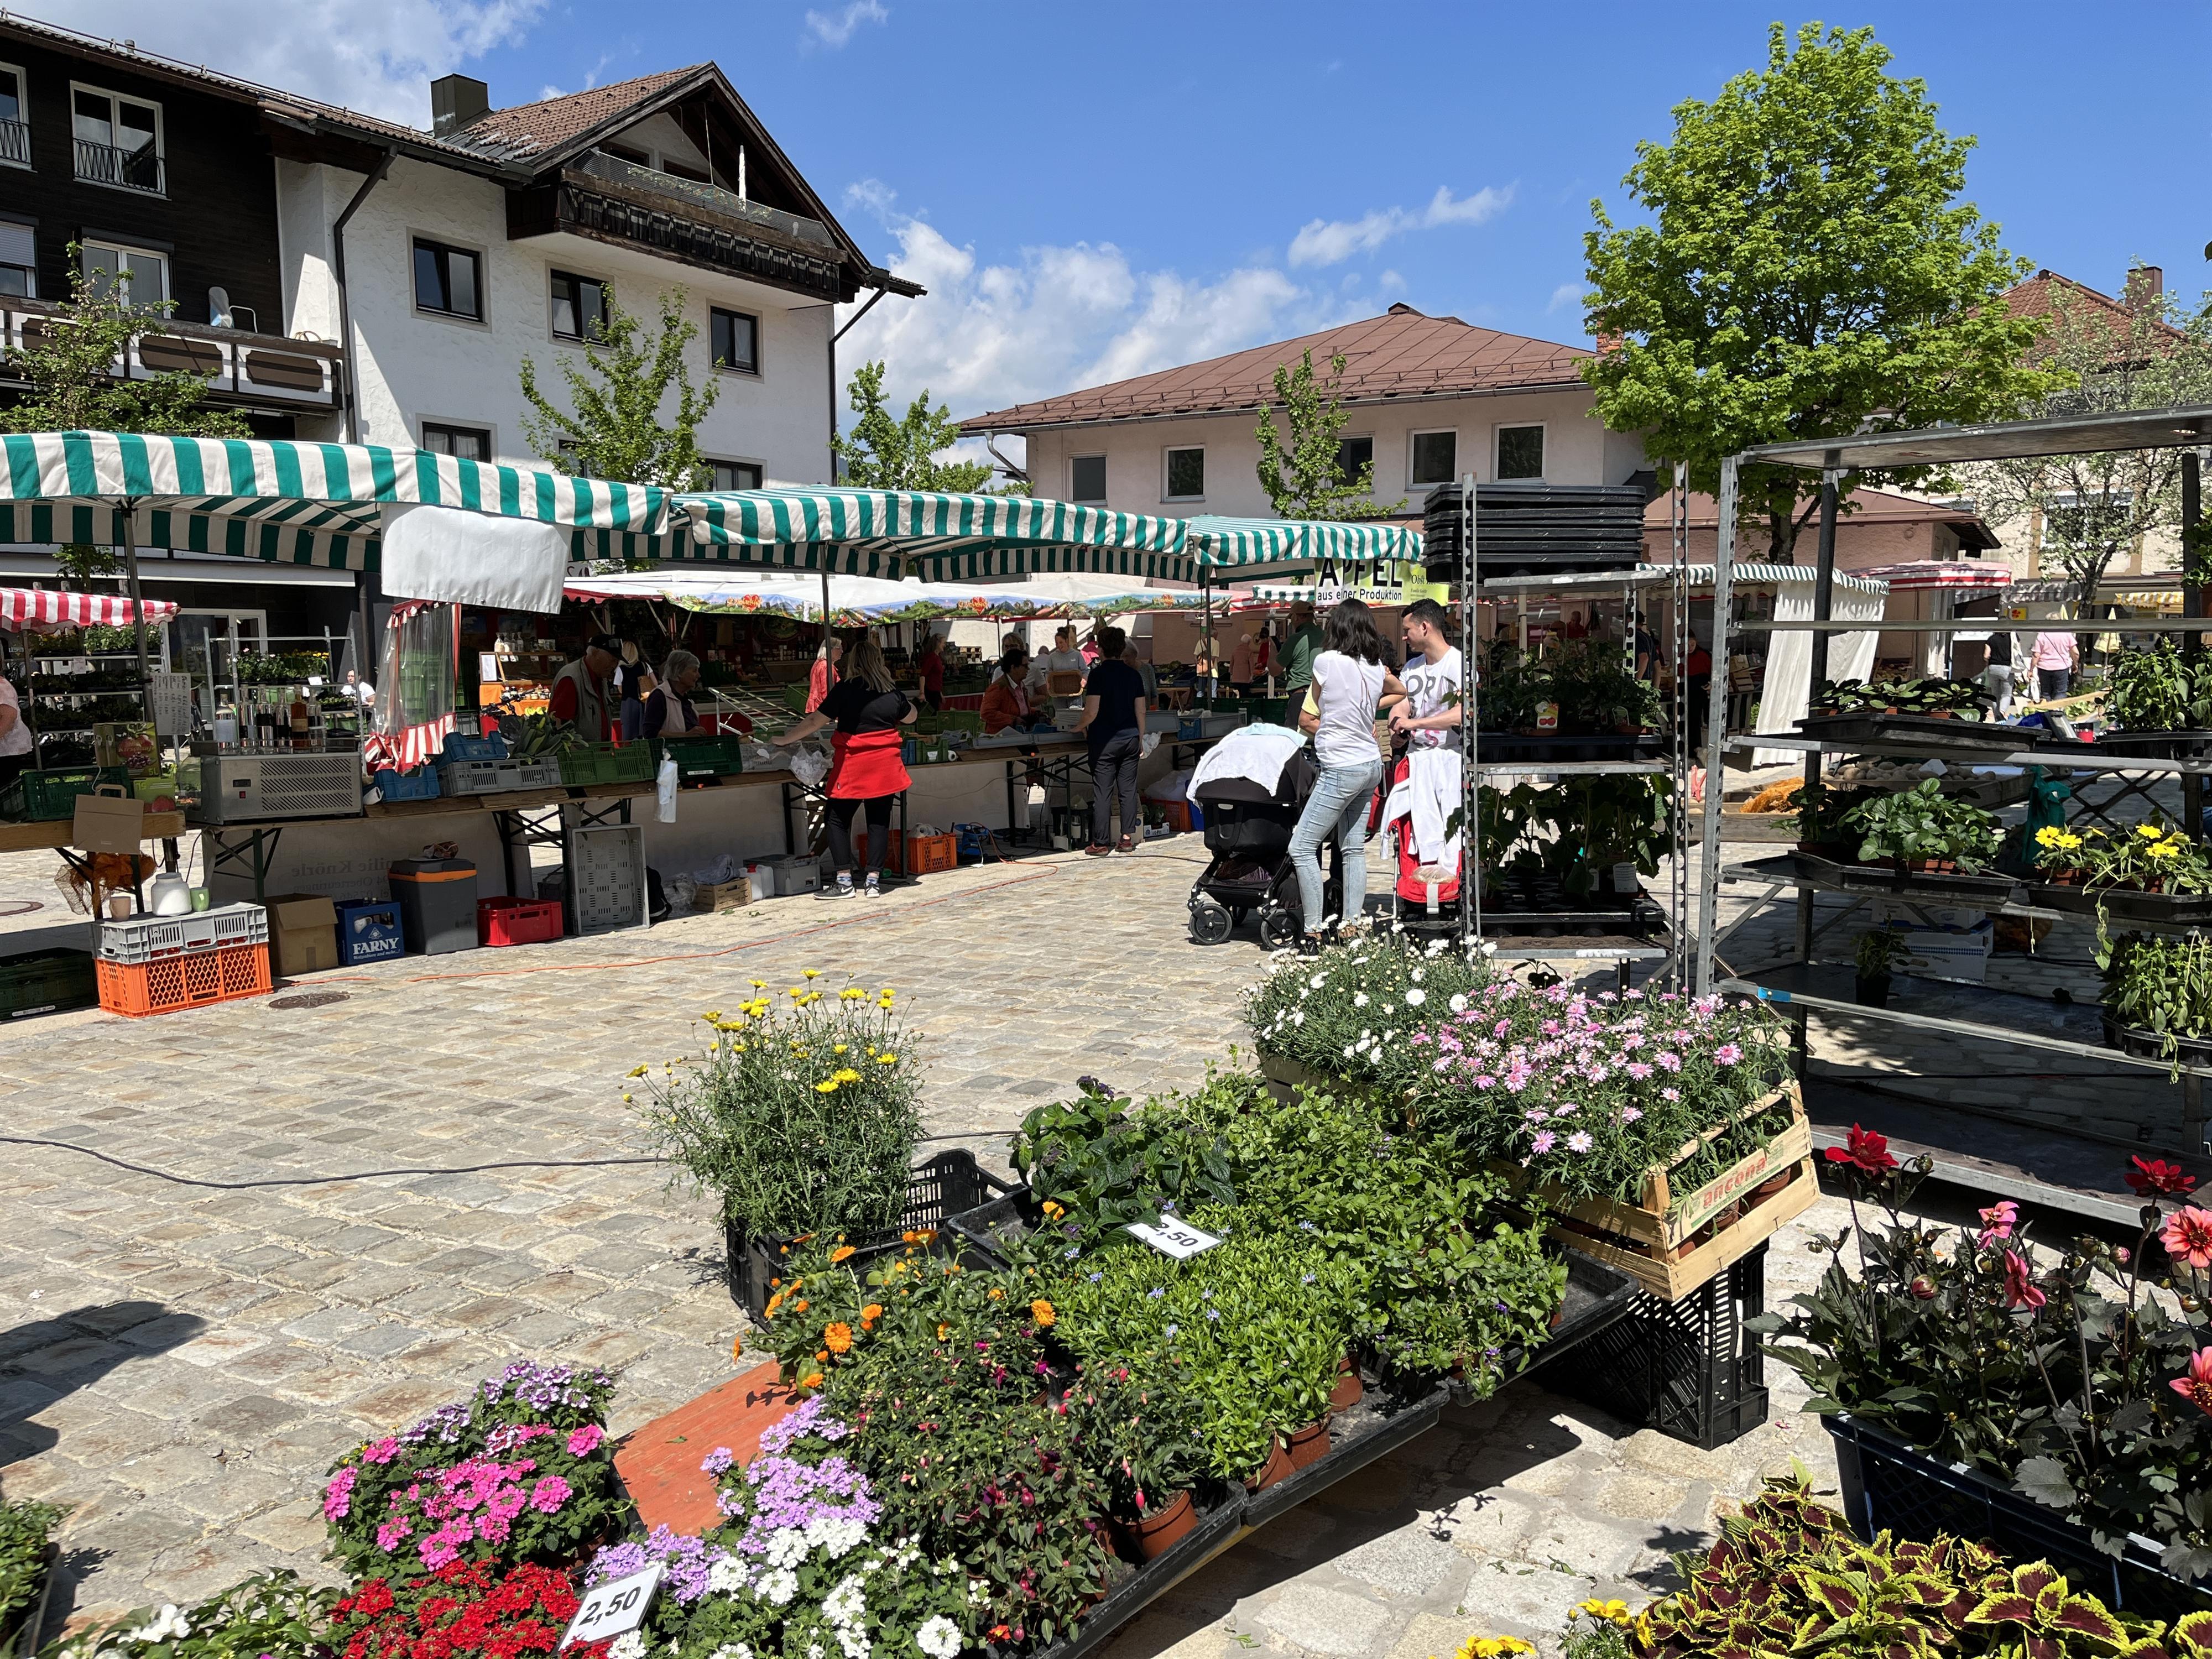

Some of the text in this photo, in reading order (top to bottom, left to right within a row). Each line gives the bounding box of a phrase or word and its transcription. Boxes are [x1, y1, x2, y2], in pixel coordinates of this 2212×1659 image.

[1318, 559, 1402, 588] APFEL
[1318, 588, 1402, 601] aus einer Produktion
[352, 937, 400, 955] FARNY
[1703, 1157, 1766, 1209] ancona
[1147, 1222, 1199, 1246] 2,50
[578, 1585, 641, 1626] 2,50
